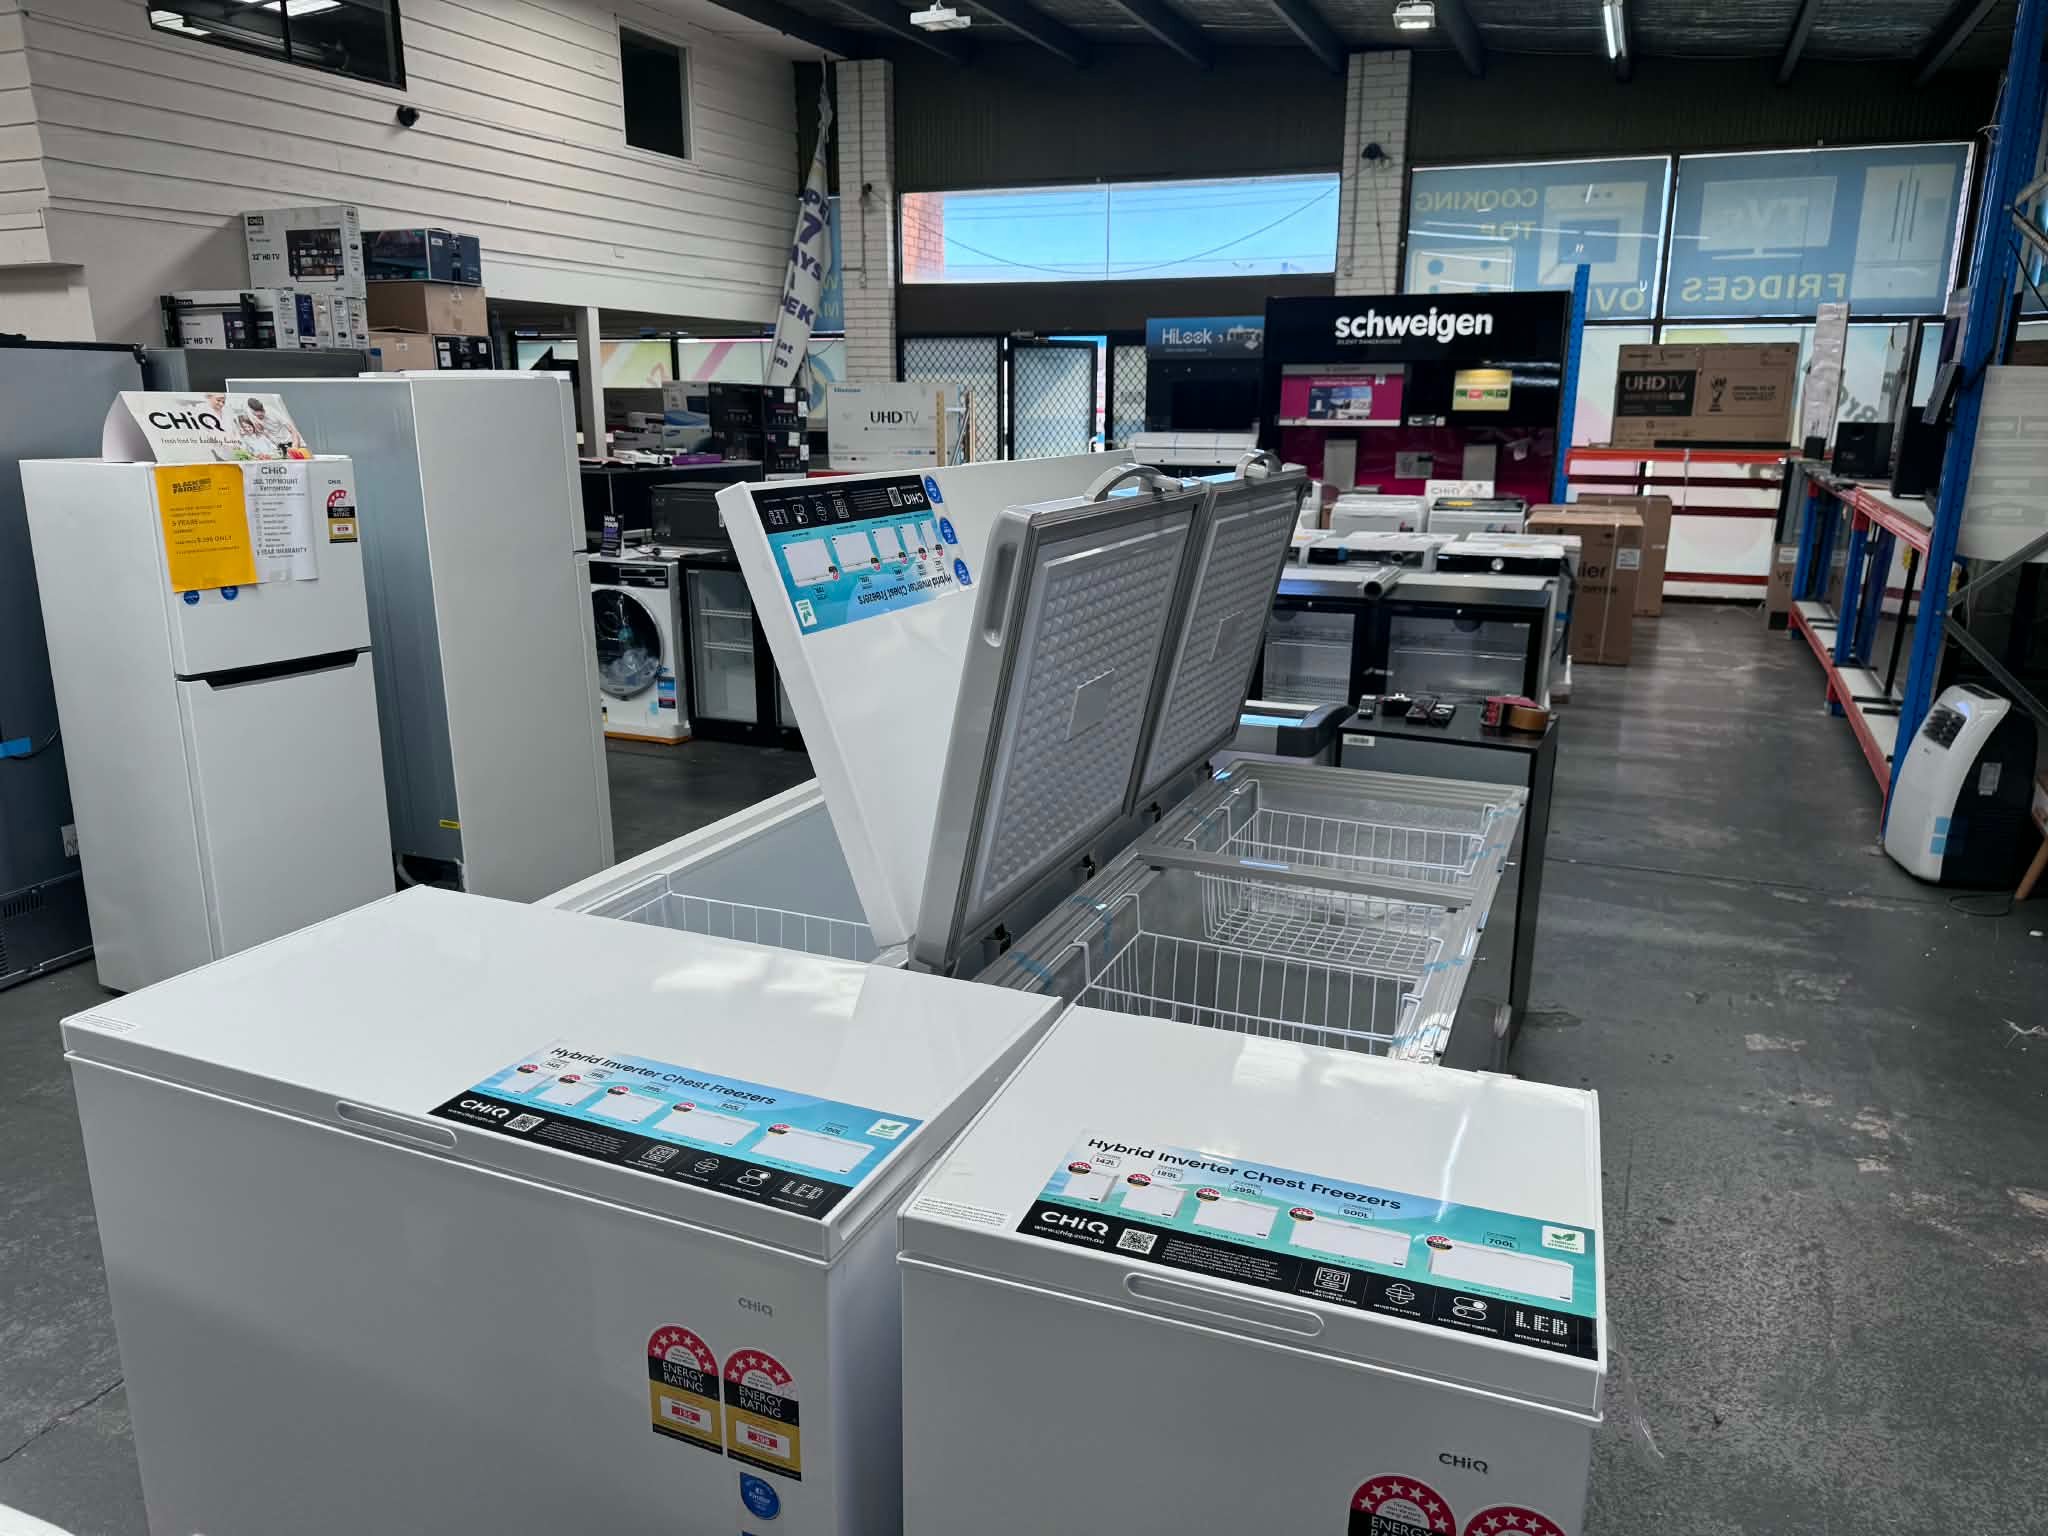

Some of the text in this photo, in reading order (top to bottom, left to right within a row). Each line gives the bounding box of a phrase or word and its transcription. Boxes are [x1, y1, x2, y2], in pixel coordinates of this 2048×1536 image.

[800, 210, 823, 245] 7
[1334, 306, 1493, 344] schweigen
[148, 411, 225, 432] CHiQ
[551, 1048, 778, 1106] Hybrid Inverter Chest Freezers
[459, 1099, 511, 1119] CHiQ
[1087, 1138, 1401, 1210] Hybrid Inverter Chest Freezers
[1040, 1211, 1109, 1237] CHiQ
[1489, 1238, 1515, 1249] 700L
[738, 1297, 773, 1318] CHiQ
[1515, 1310, 1568, 1336] LED
[662, 1361, 705, 1382] ENERGY
[663, 1372, 704, 1394] RATING
[738, 1384, 783, 1409] ENERGY
[740, 1397, 782, 1419] RATING
[1438, 1452, 1490, 1475] CHiQ
